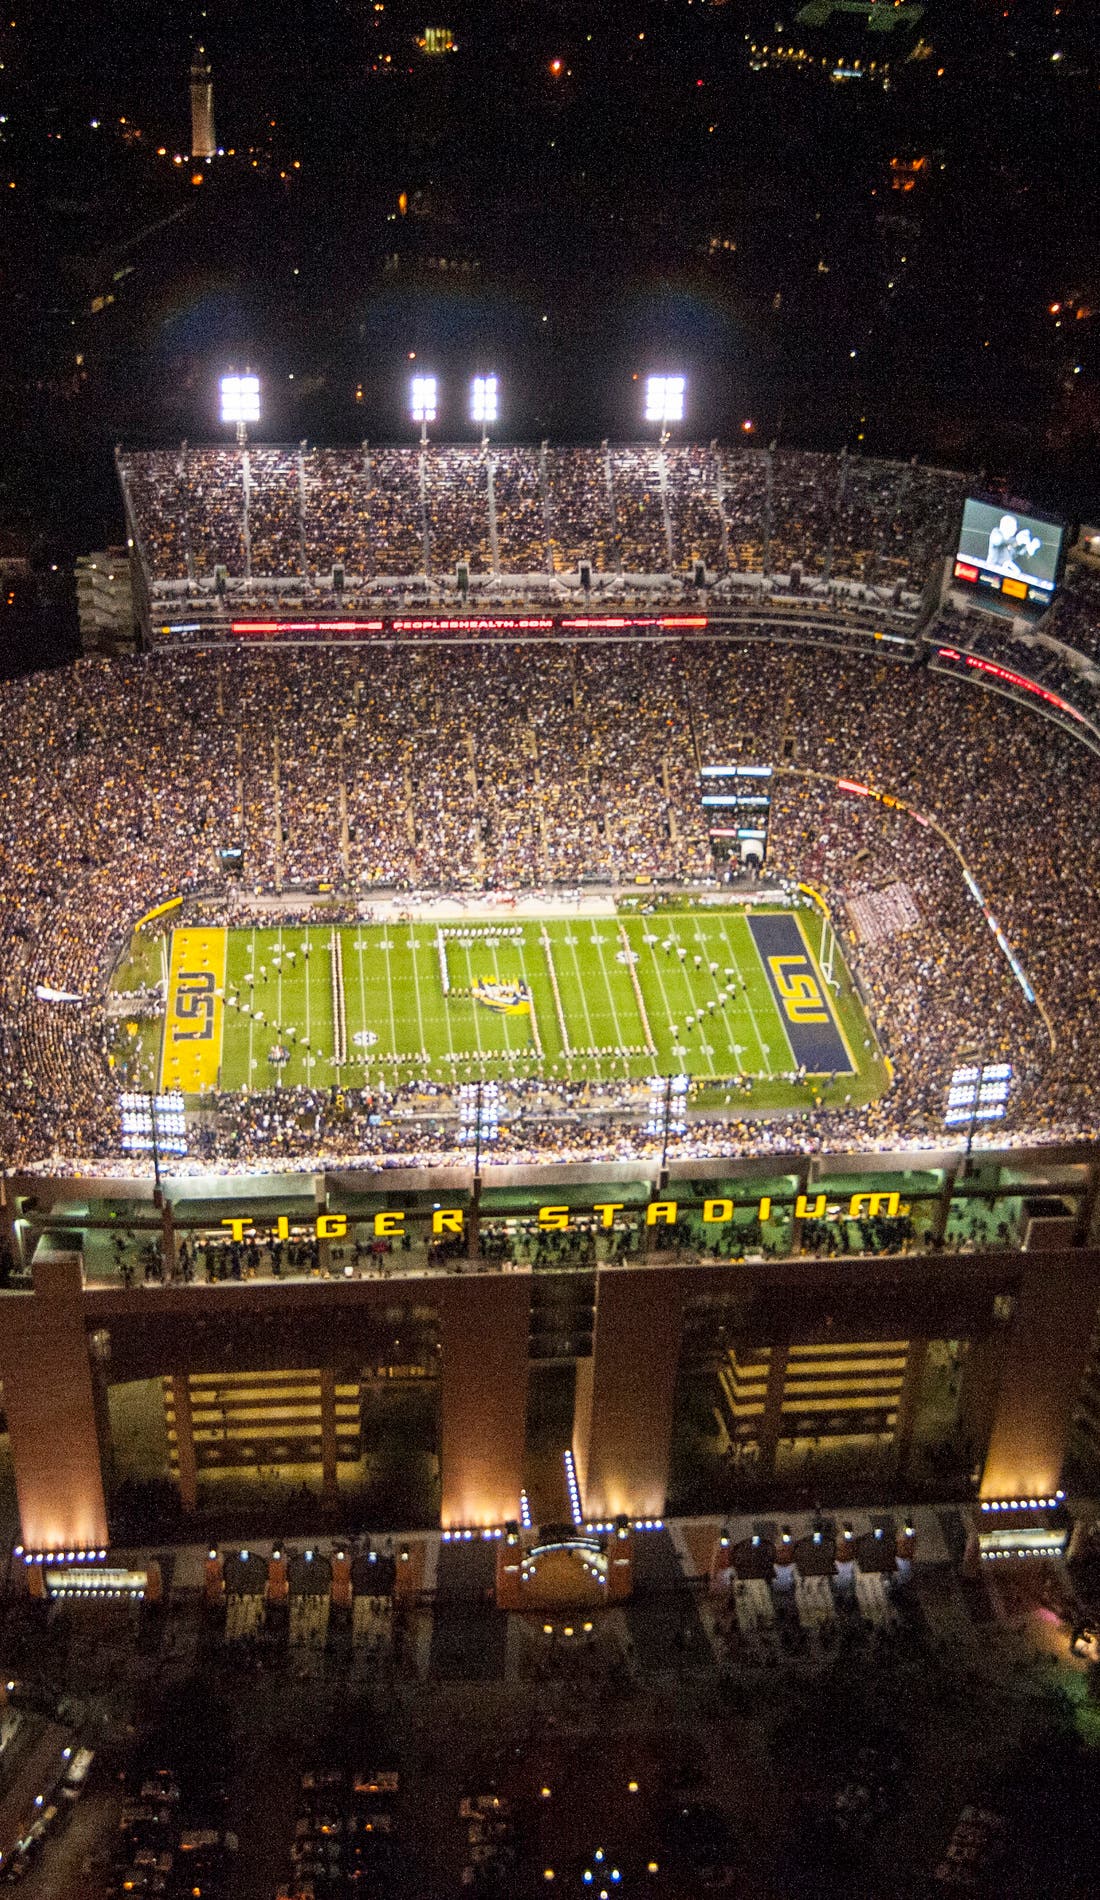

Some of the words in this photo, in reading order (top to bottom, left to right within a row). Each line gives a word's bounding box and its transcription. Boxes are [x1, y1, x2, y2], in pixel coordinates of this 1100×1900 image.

[173, 972, 215, 1041] LSU
[767, 954, 830, 1024] LSU
[221, 1209, 464, 1242] TIGER
[537, 1192, 901, 1230] STADIUM
